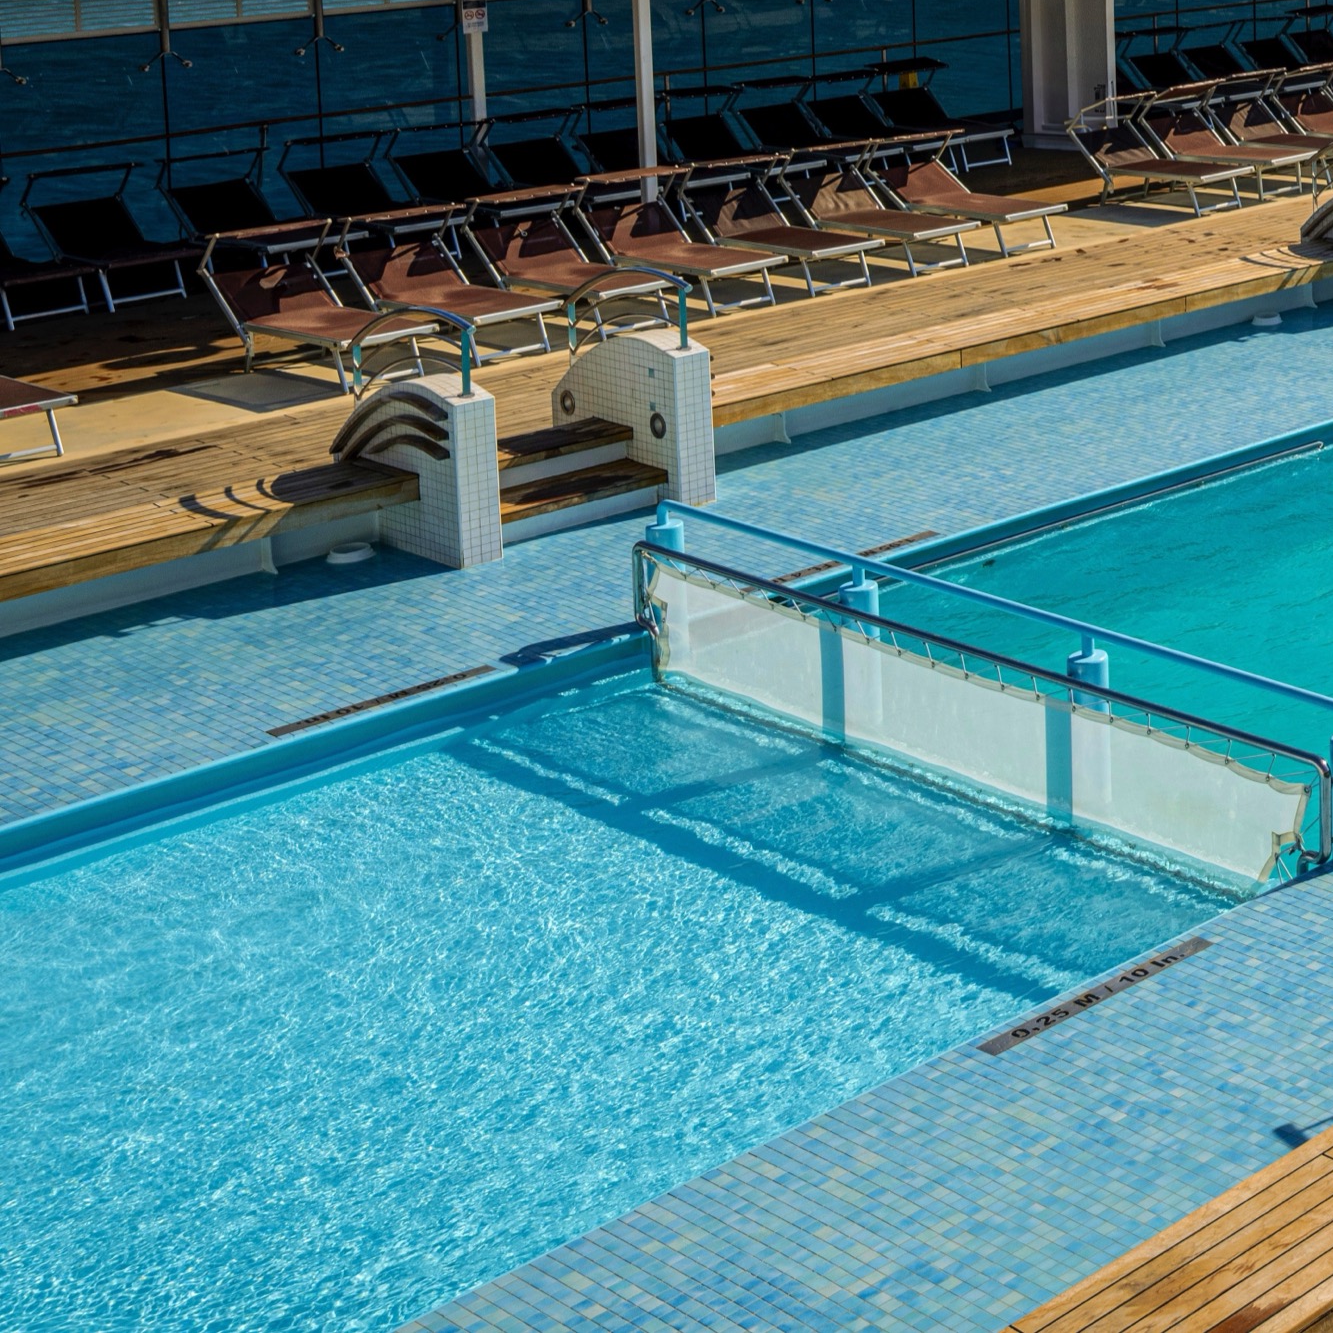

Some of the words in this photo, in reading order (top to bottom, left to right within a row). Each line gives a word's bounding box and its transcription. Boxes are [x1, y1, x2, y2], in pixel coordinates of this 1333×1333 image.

[388, 690, 408, 699] M
[336, 704, 364, 715] 10
[1011, 1008, 1070, 1039] 0,25
[1073, 993, 1100, 1008] M
[1118, 968, 1150, 984] 10
[1150, 952, 1186, 968] In.
